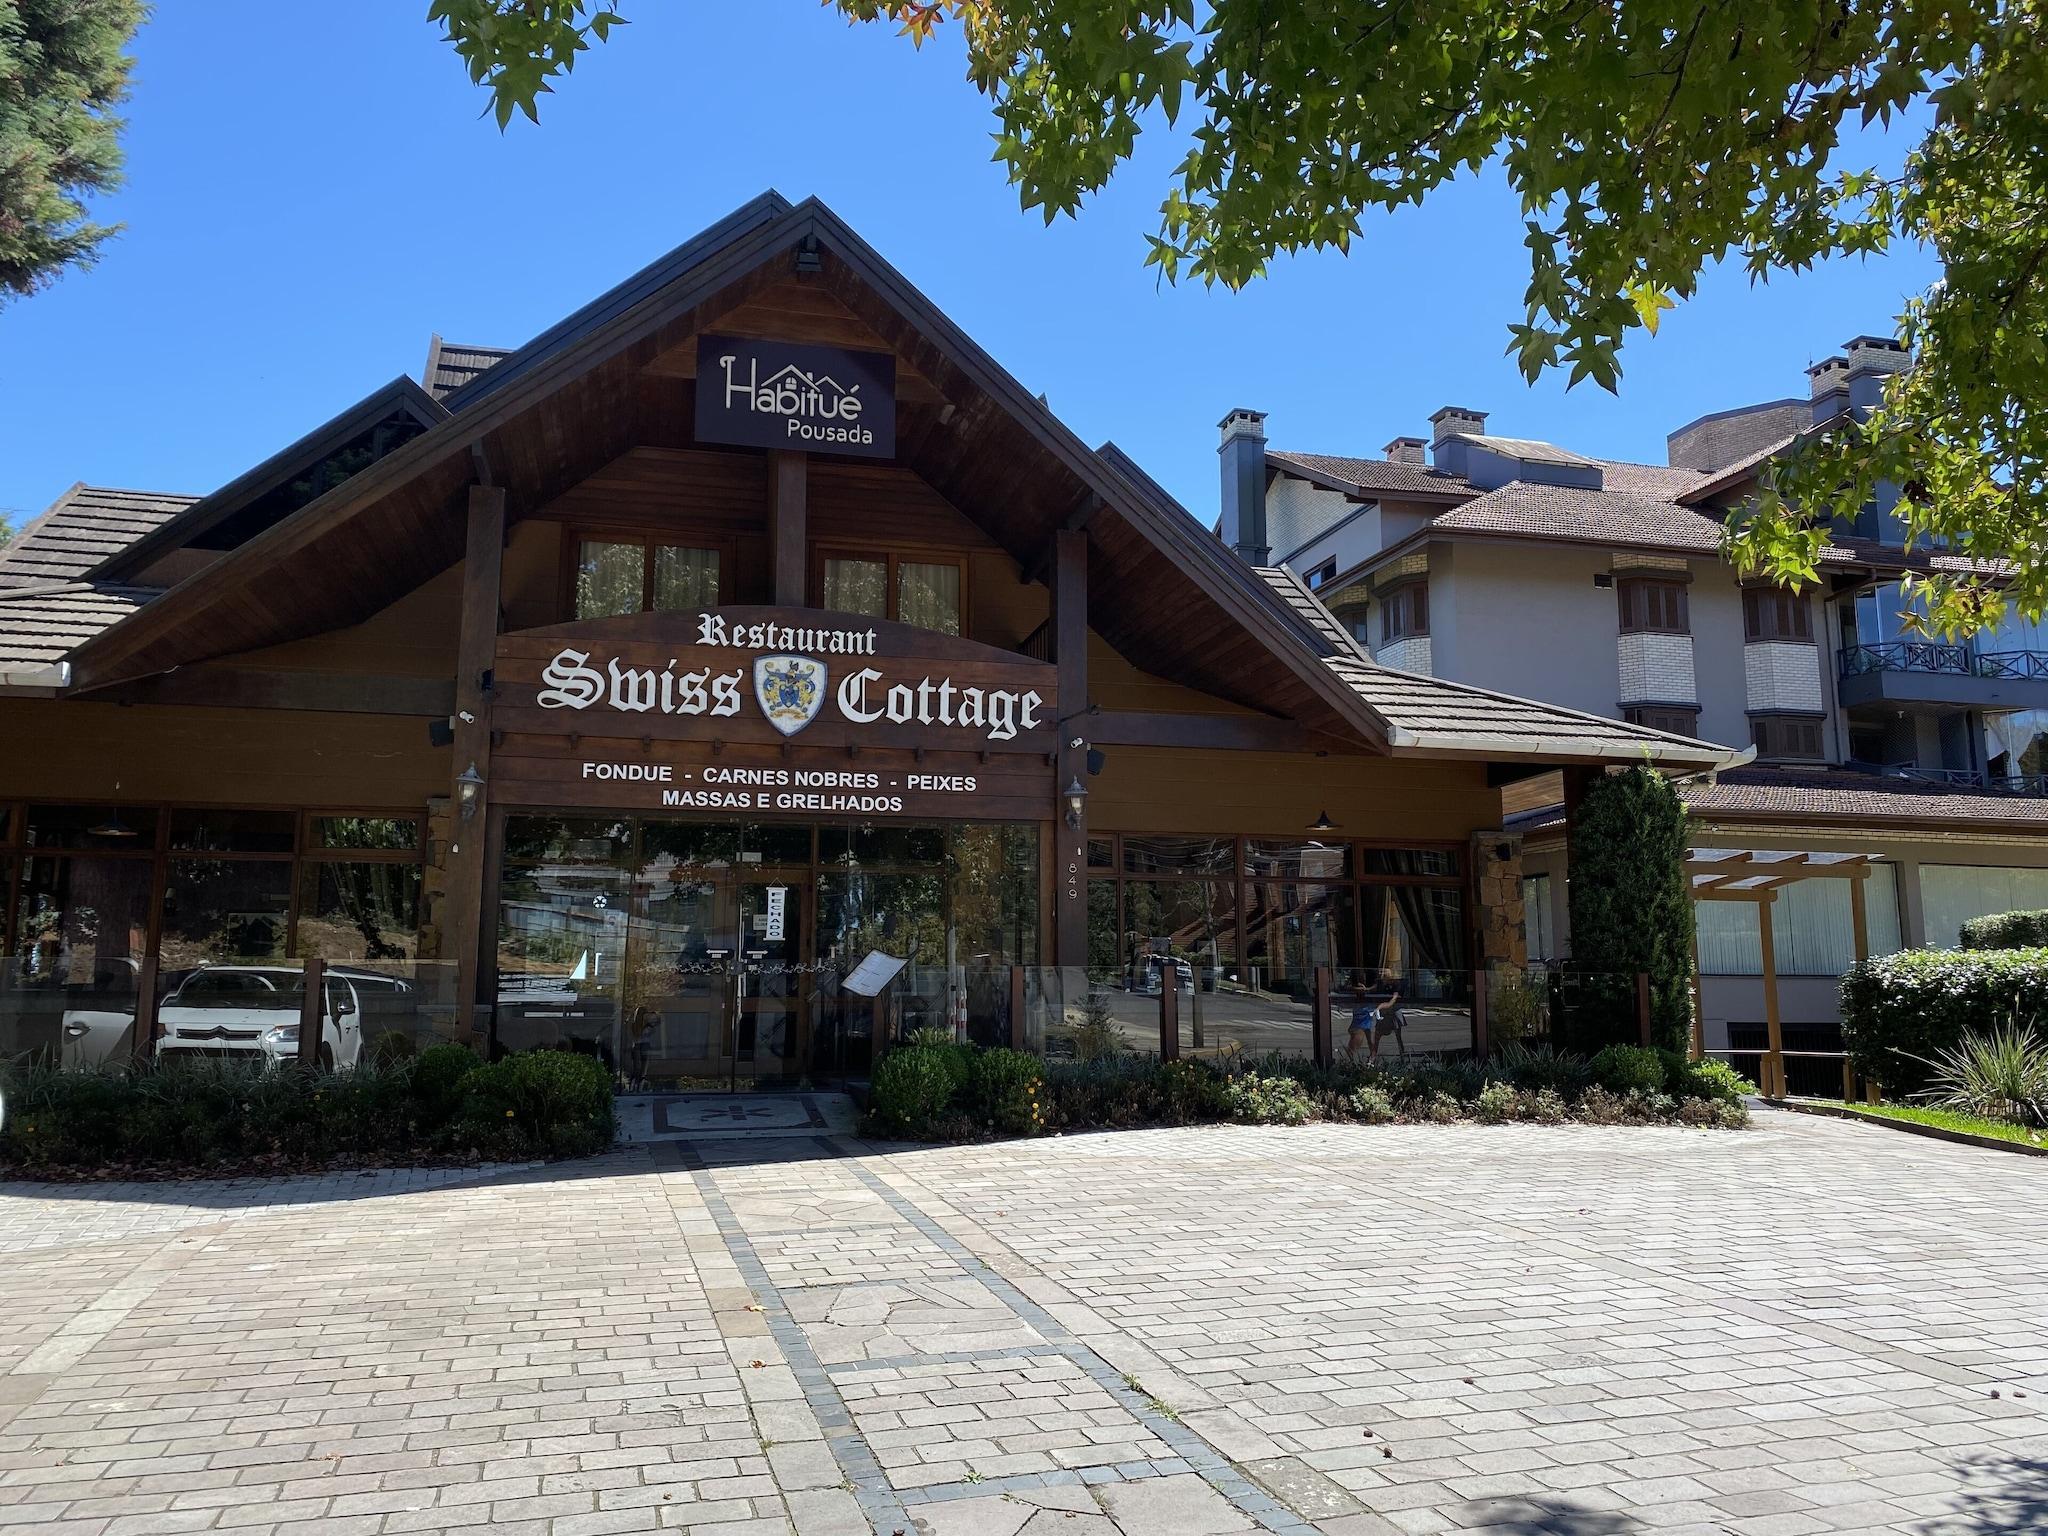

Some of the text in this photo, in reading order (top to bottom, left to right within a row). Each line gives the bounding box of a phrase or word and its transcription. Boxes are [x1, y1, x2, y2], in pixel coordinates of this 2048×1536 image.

[720, 356, 862, 420] Habitué
[787, 419, 873, 445] Pousada
[695, 613, 877, 656] Restaurant
[536, 648, 1043, 741] Swiss Cottage
[582, 762, 673, 782] FONDUE
[703, 767, 789, 786] CARNES
[794, 771, 879, 789] NOBRES
[907, 774, 977, 792] PEIXES
[662, 790, 903, 812] MASSAS E GRELHADOS
[1068, 863, 1077, 899] 849
[769, 892, 782, 936] FECHADO
